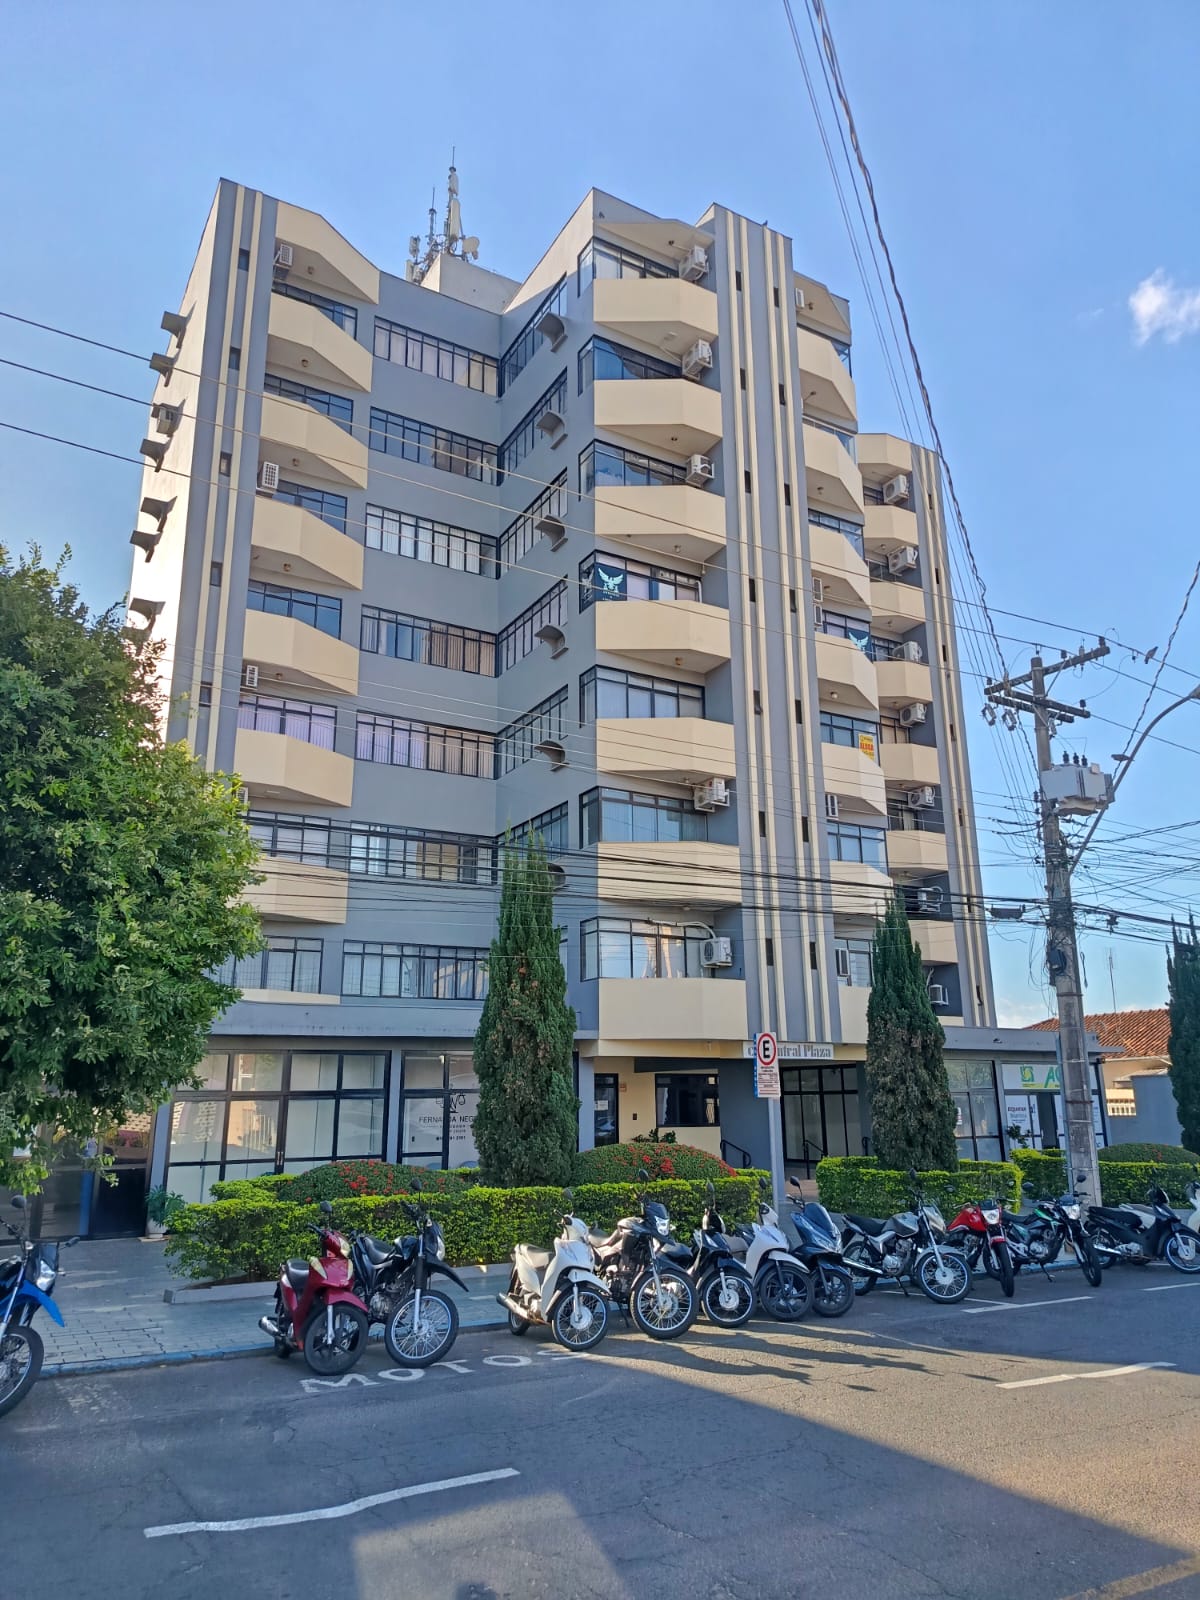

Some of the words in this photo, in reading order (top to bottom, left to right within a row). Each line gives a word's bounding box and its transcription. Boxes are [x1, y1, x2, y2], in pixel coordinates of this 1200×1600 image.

[763, 1040, 770, 1058] E
[803, 1044, 831, 1057] Plaza
[418, 1116, 457, 1124] FERNADA
[459, 1115, 476, 1123] NEG
